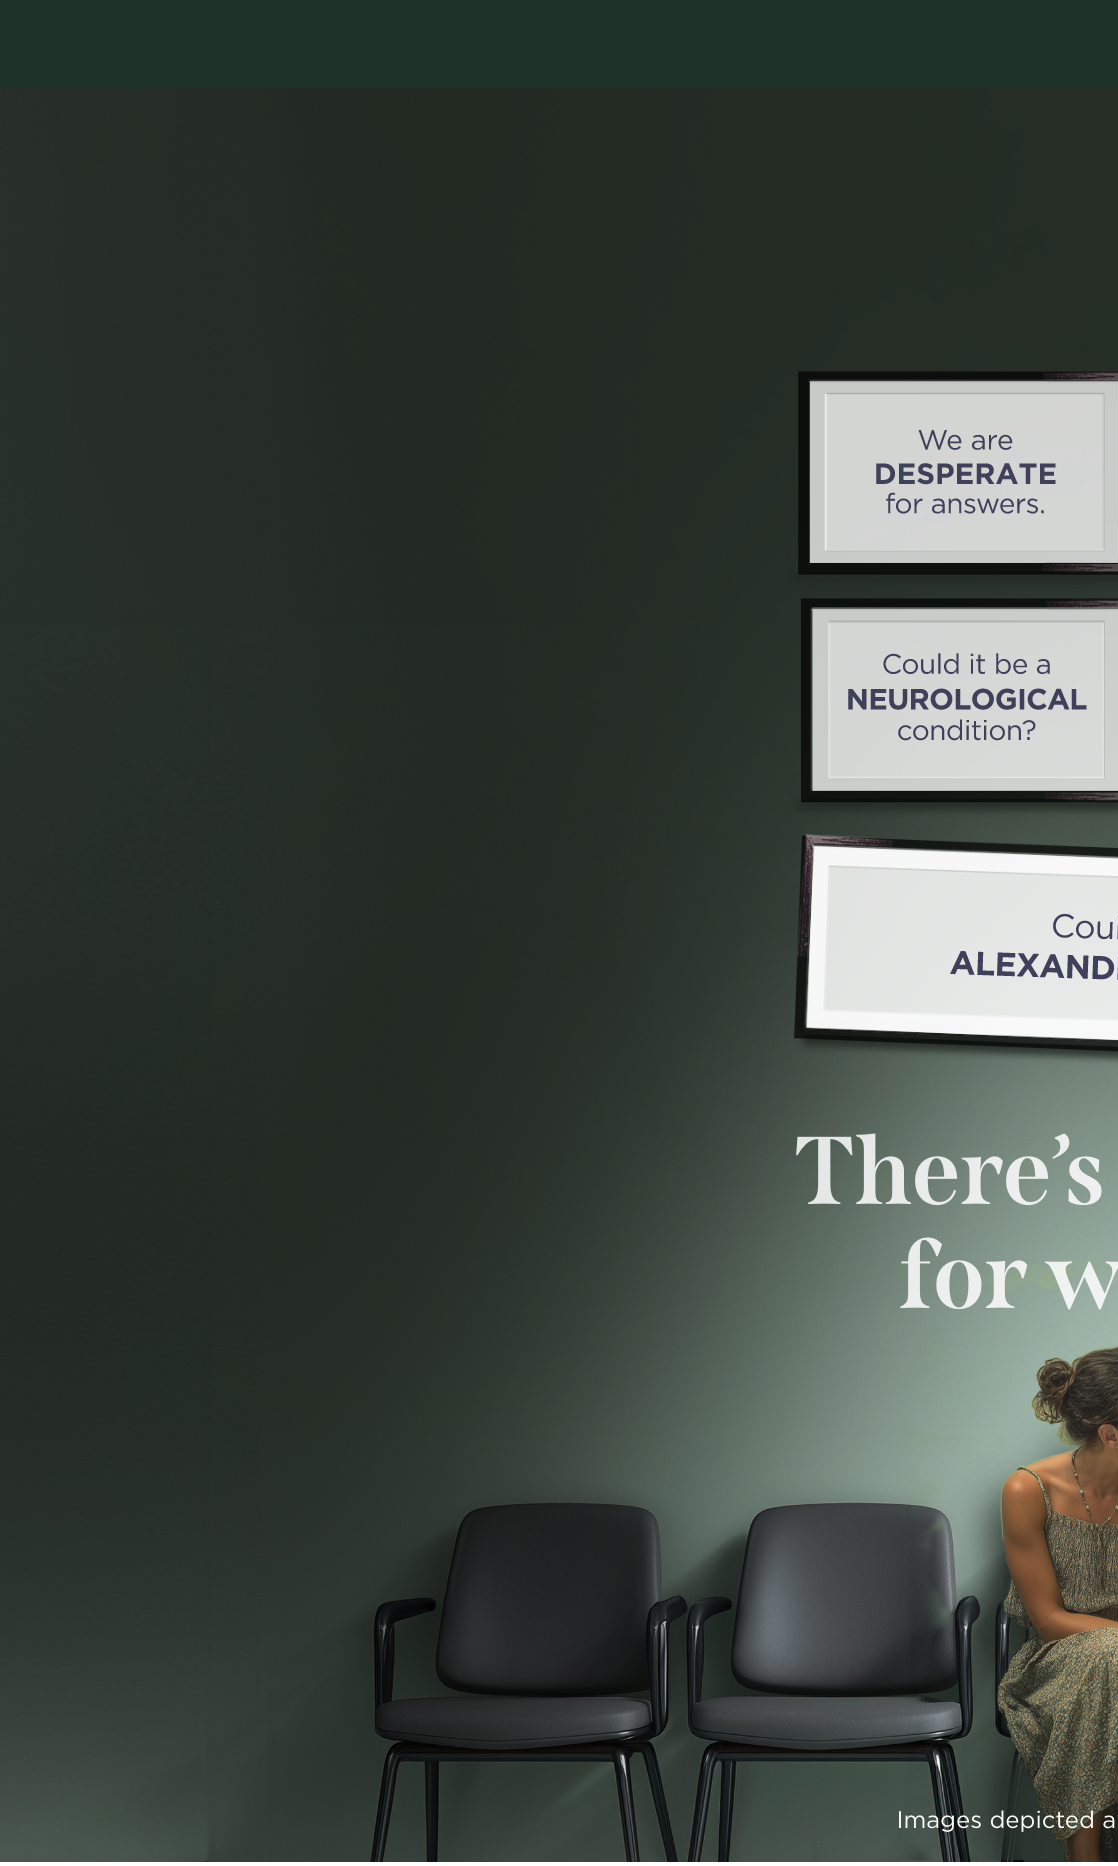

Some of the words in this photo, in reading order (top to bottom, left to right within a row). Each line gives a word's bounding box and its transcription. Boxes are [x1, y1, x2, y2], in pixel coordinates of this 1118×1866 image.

[918, 429, 963, 451] We
[971, 434, 1013, 451] are
[875, 462, 1057, 485] DESPERATE
[885, 492, 924, 515] for
[931, 497, 1045, 515] answers.
[882, 652, 960, 675] Could
[970, 653, 986, 675] it
[995, 652, 1028, 675] be
[1036, 658, 1051, 675] a
[847, 687, 1088, 711] NEUROLOGICAL
[897, 718, 1037, 741] condition?
